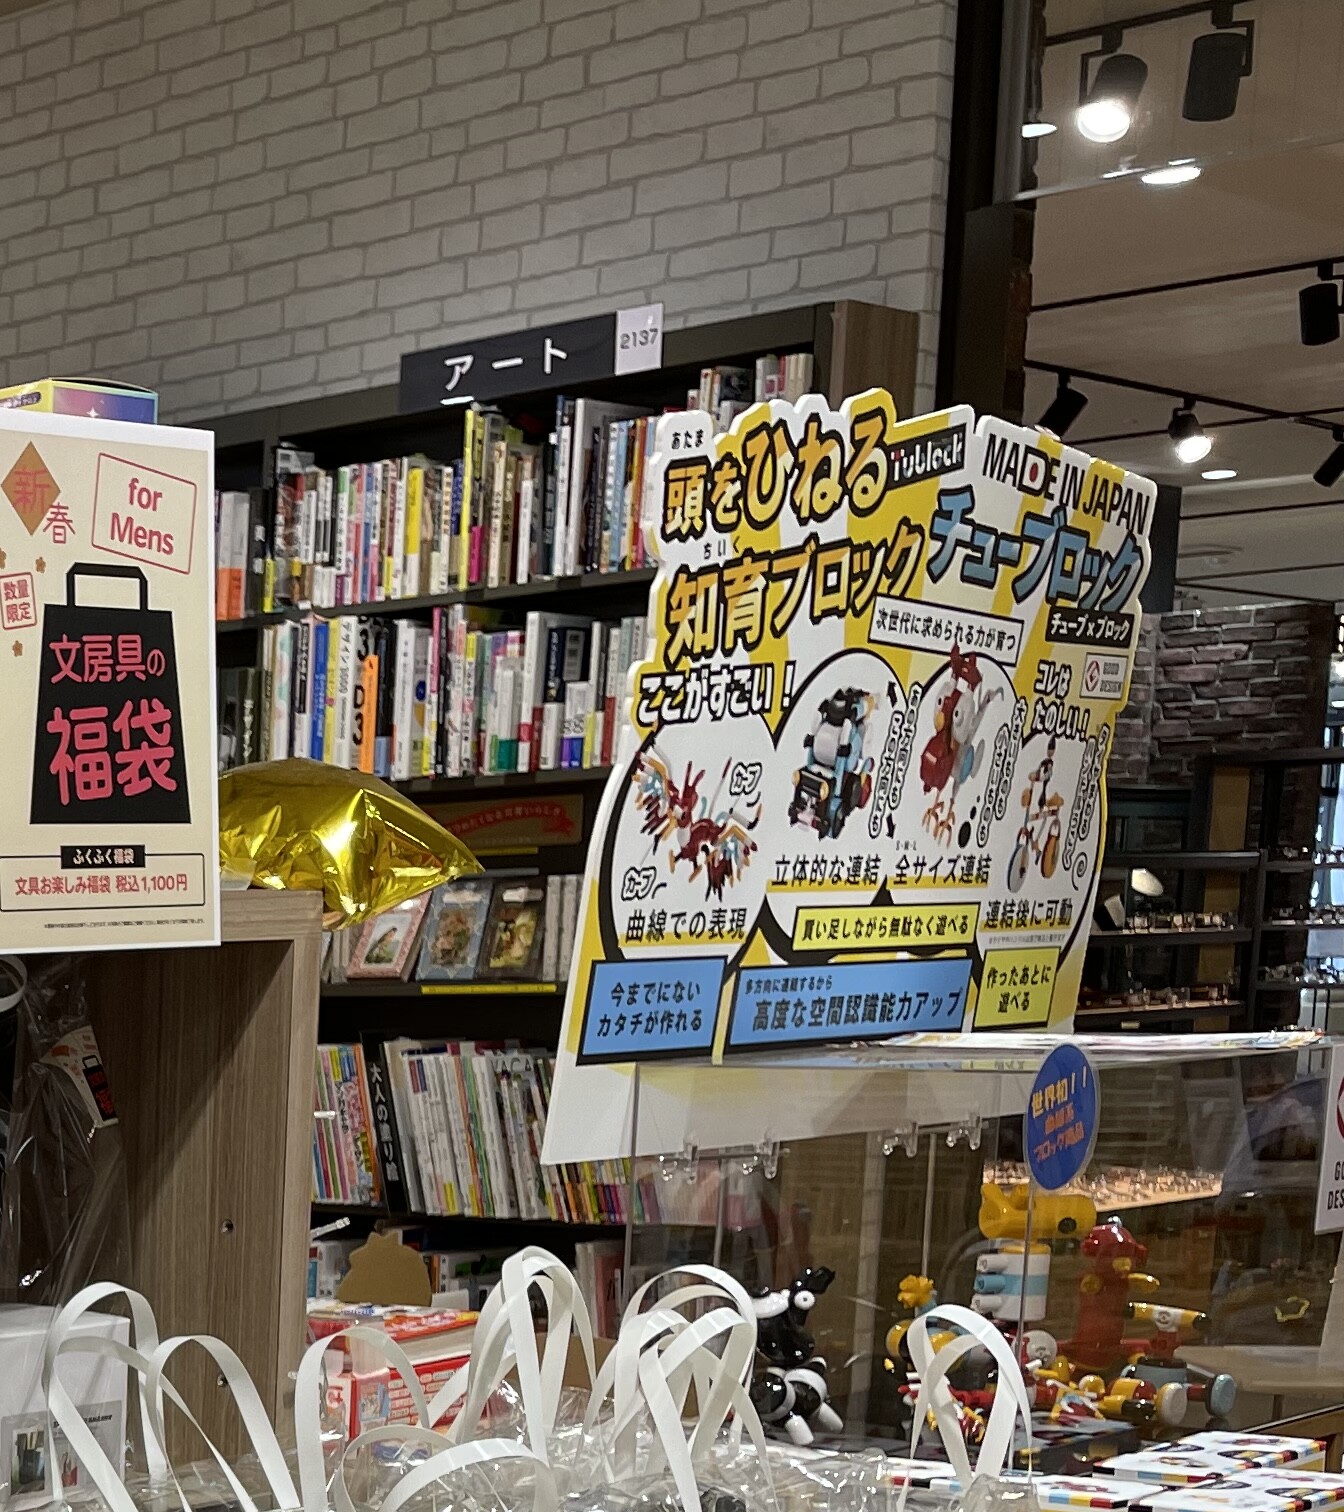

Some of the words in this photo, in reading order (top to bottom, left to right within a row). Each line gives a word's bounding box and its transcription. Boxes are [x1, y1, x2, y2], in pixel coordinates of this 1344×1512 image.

[618, 328, 660, 350] 2137
[445, 337, 568, 390] アート
[671, 430, 704, 450] あたま
[664, 408, 887, 539] 頭をひねる
[892, 434, 964, 481] Tublock
[128, 477, 162, 511] for
[983, 434, 1058, 497] MADE
[1062, 466, 1085, 510] IN
[1084, 473, 1149, 535] JAPAN
[111, 513, 174, 556] Mens
[928, 486, 1143, 613] チューブロック
[3, 580, 28, 600] 数量
[667, 521, 923, 667] 知育ブロック
[6, 602, 31, 622] 限定
[878, 608, 1015, 651] 次世代に求められる力が育つ
[50, 633, 165, 682] 文房具の
[1036, 662, 1072, 696] コレは
[47, 699, 177, 804] 福袋
[72, 849, 134, 865] ふくふく福袋
[775, 854, 881, 887] 立体的な連結
[894, 854, 992, 887] 全サイズ連結
[15, 876, 111, 895] 文具お楽しみ福袋
[116, 876, 140, 893] 税込
[625, 907, 746, 943] 曲線での表現
[802, 911, 969, 940] 買い足しながら無駄なく遊べる
[985, 899, 1073, 929] 連結後に可動
[611, 983, 701, 1003] 今までにない
[987, 965, 1052, 989] 作ったあとに
[753, 989, 963, 1031] 高度な空間認識能力アップ
[998, 992, 1030, 1014] 遊べる
[597, 1013, 702, 1038] カタチが作れる
